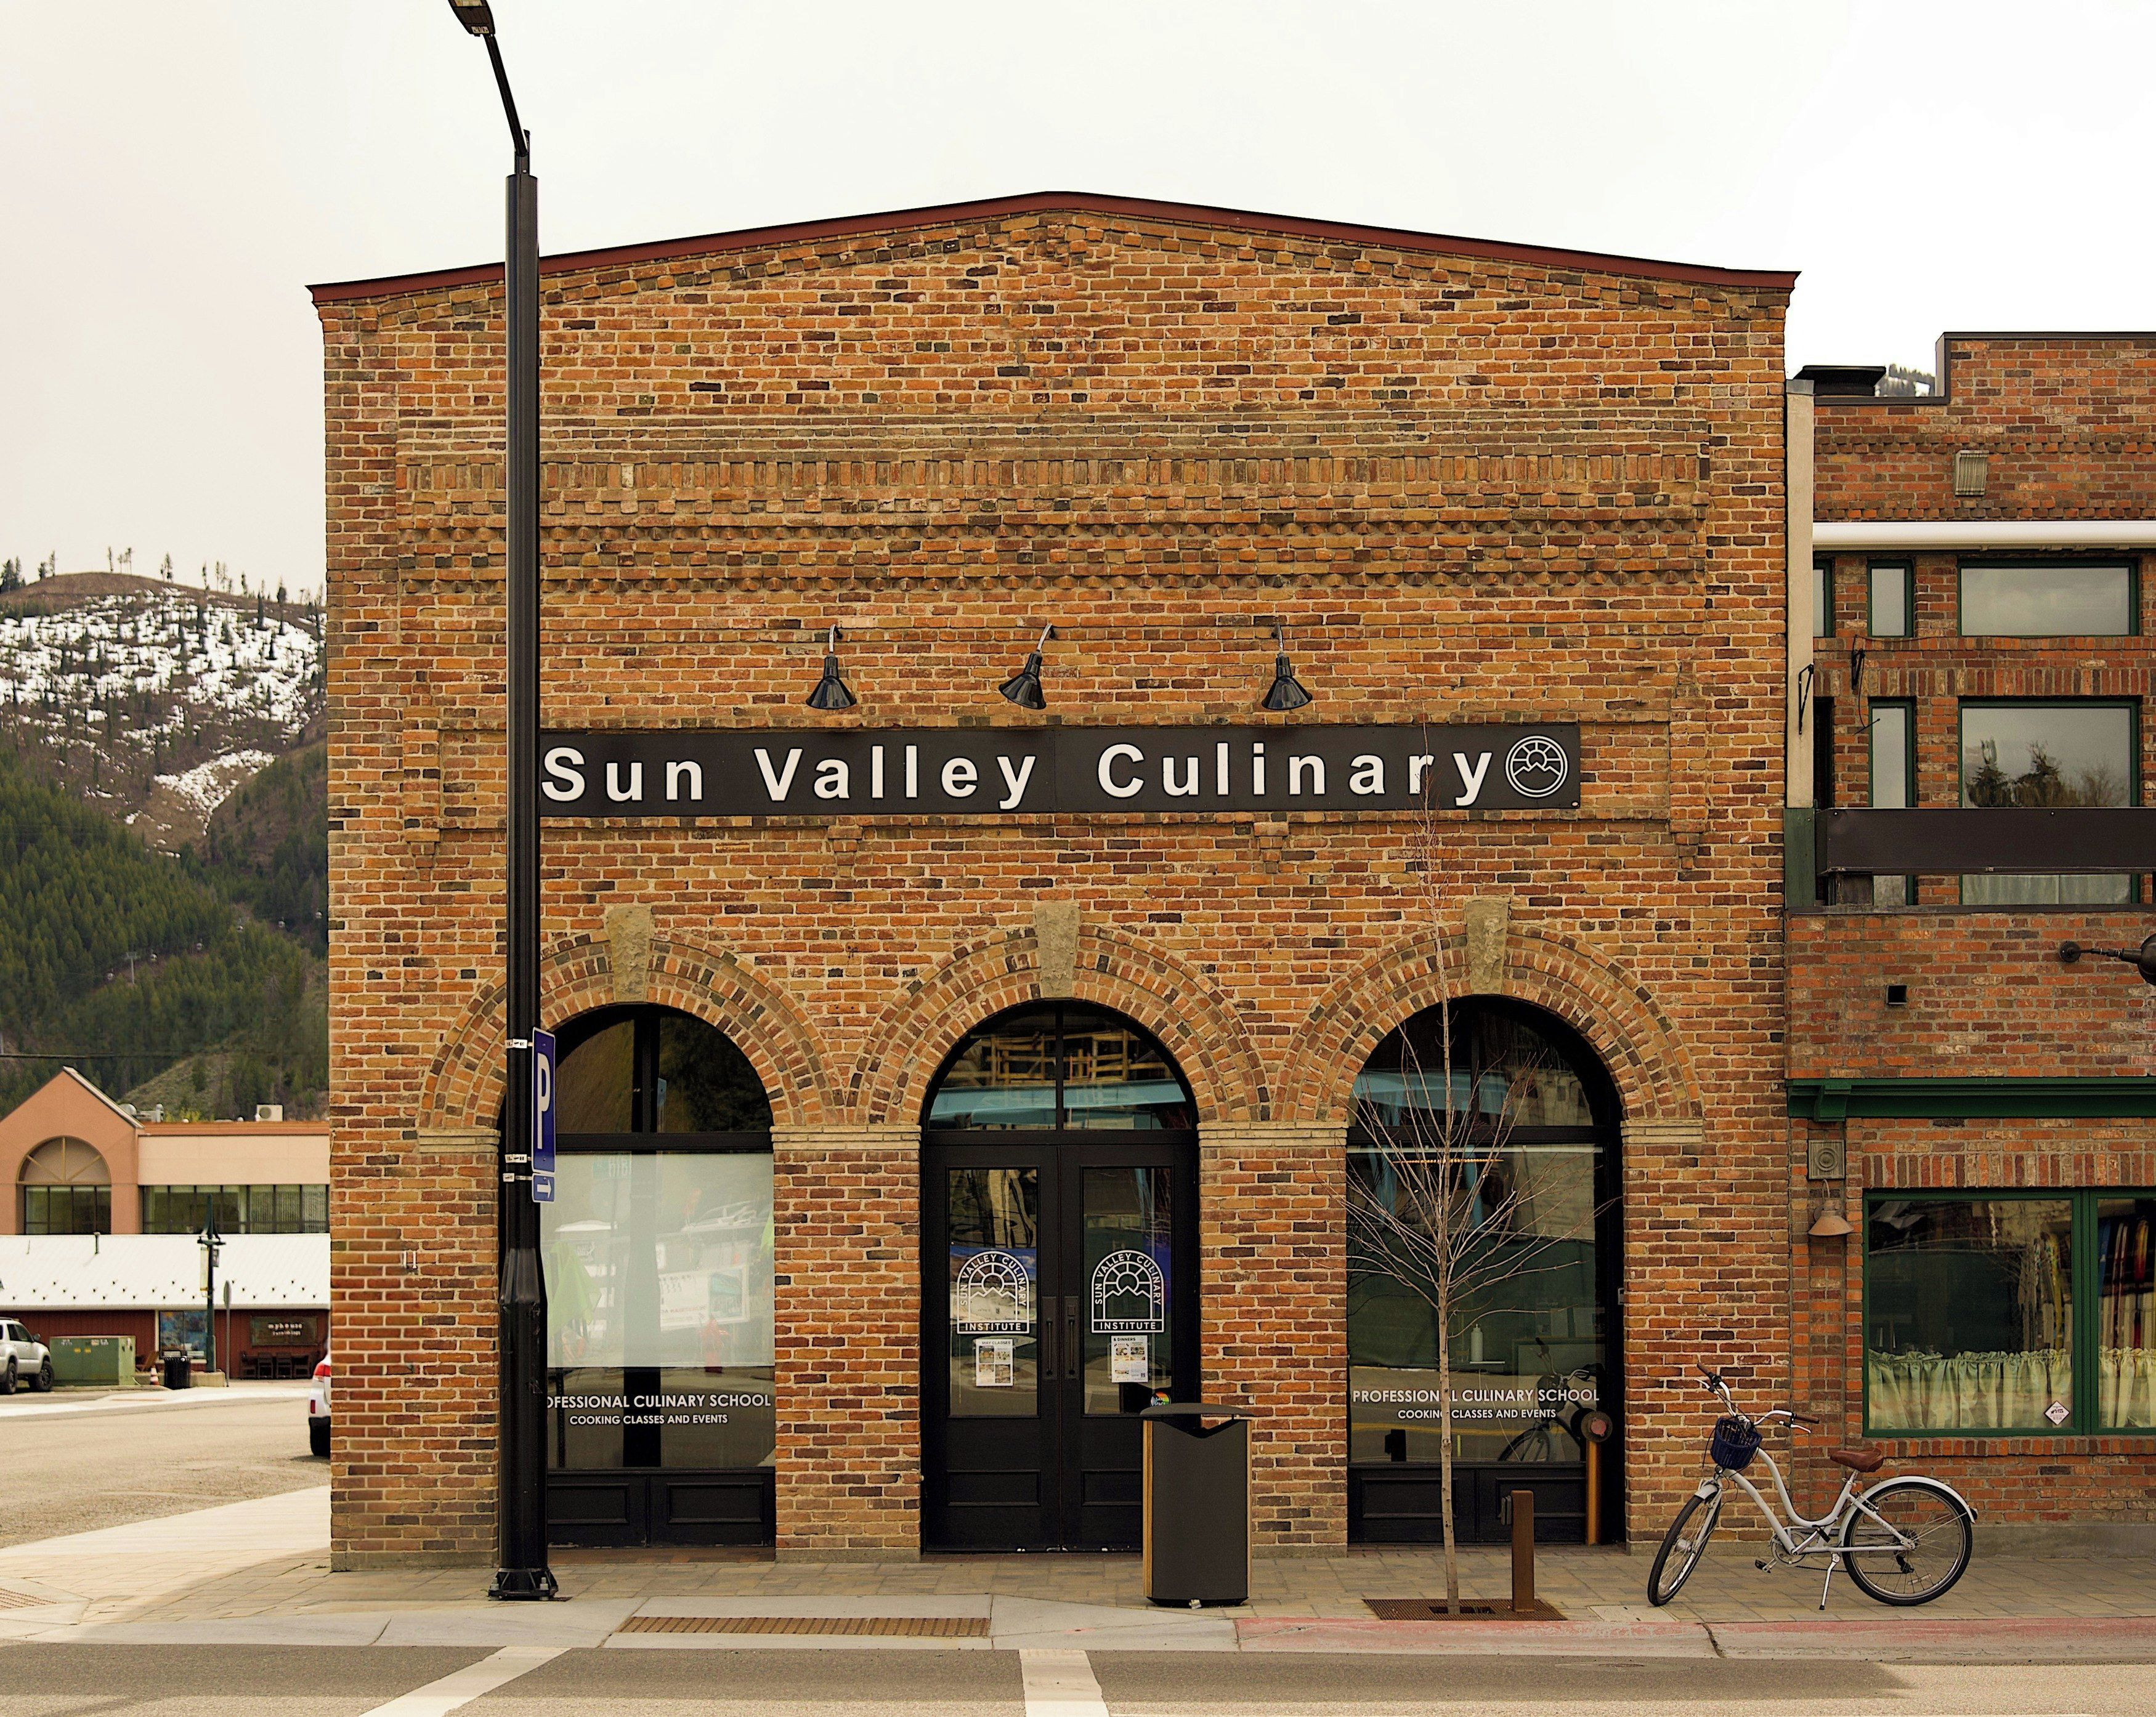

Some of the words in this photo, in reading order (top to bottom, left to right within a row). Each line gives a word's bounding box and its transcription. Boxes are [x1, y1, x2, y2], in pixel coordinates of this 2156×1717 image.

[541, 747, 702, 801] Sun
[754, 745, 1035, 809] Valley
[1098, 743, 1492, 806] Culinary
[537, 1052, 551, 1149] P
[962, 1254, 997, 1279] VALLEY
[1096, 1253, 1132, 1277] VALLEY
[1002, 1256, 1027, 1306] CULINARY
[1137, 1256, 1161, 1305] CULINARY
[960, 1284, 968, 1306] SUN
[1095, 1283, 1103, 1305] SUN
[965, 1323, 1021, 1331] INSTITUTE
[1100, 1322, 1156, 1330] INSTITUTE
[547, 1396, 630, 1408] OFESSIONAL
[634, 1394, 705, 1407] CULINARY
[710, 1394, 771, 1407] SCHOOL
[1353, 1389, 1458, 1402] PROFESSIONL
[1462, 1389, 1534, 1402] CULINARY
[1538, 1389, 1599, 1402] SCHOOL
[570, 1415, 620, 1425] COOKING
[623, 1415, 665, 1424] CLASSES
[667, 1415, 690, 1424] AND
[693, 1414, 728, 1424] EVENTS
[1398, 1410, 1443, 1419] COOKIN
[1451, 1409, 1493, 1419] CLASSES
[1496, 1409, 1518, 1418] AND
[1521, 1408, 1557, 1418] EVENTS
